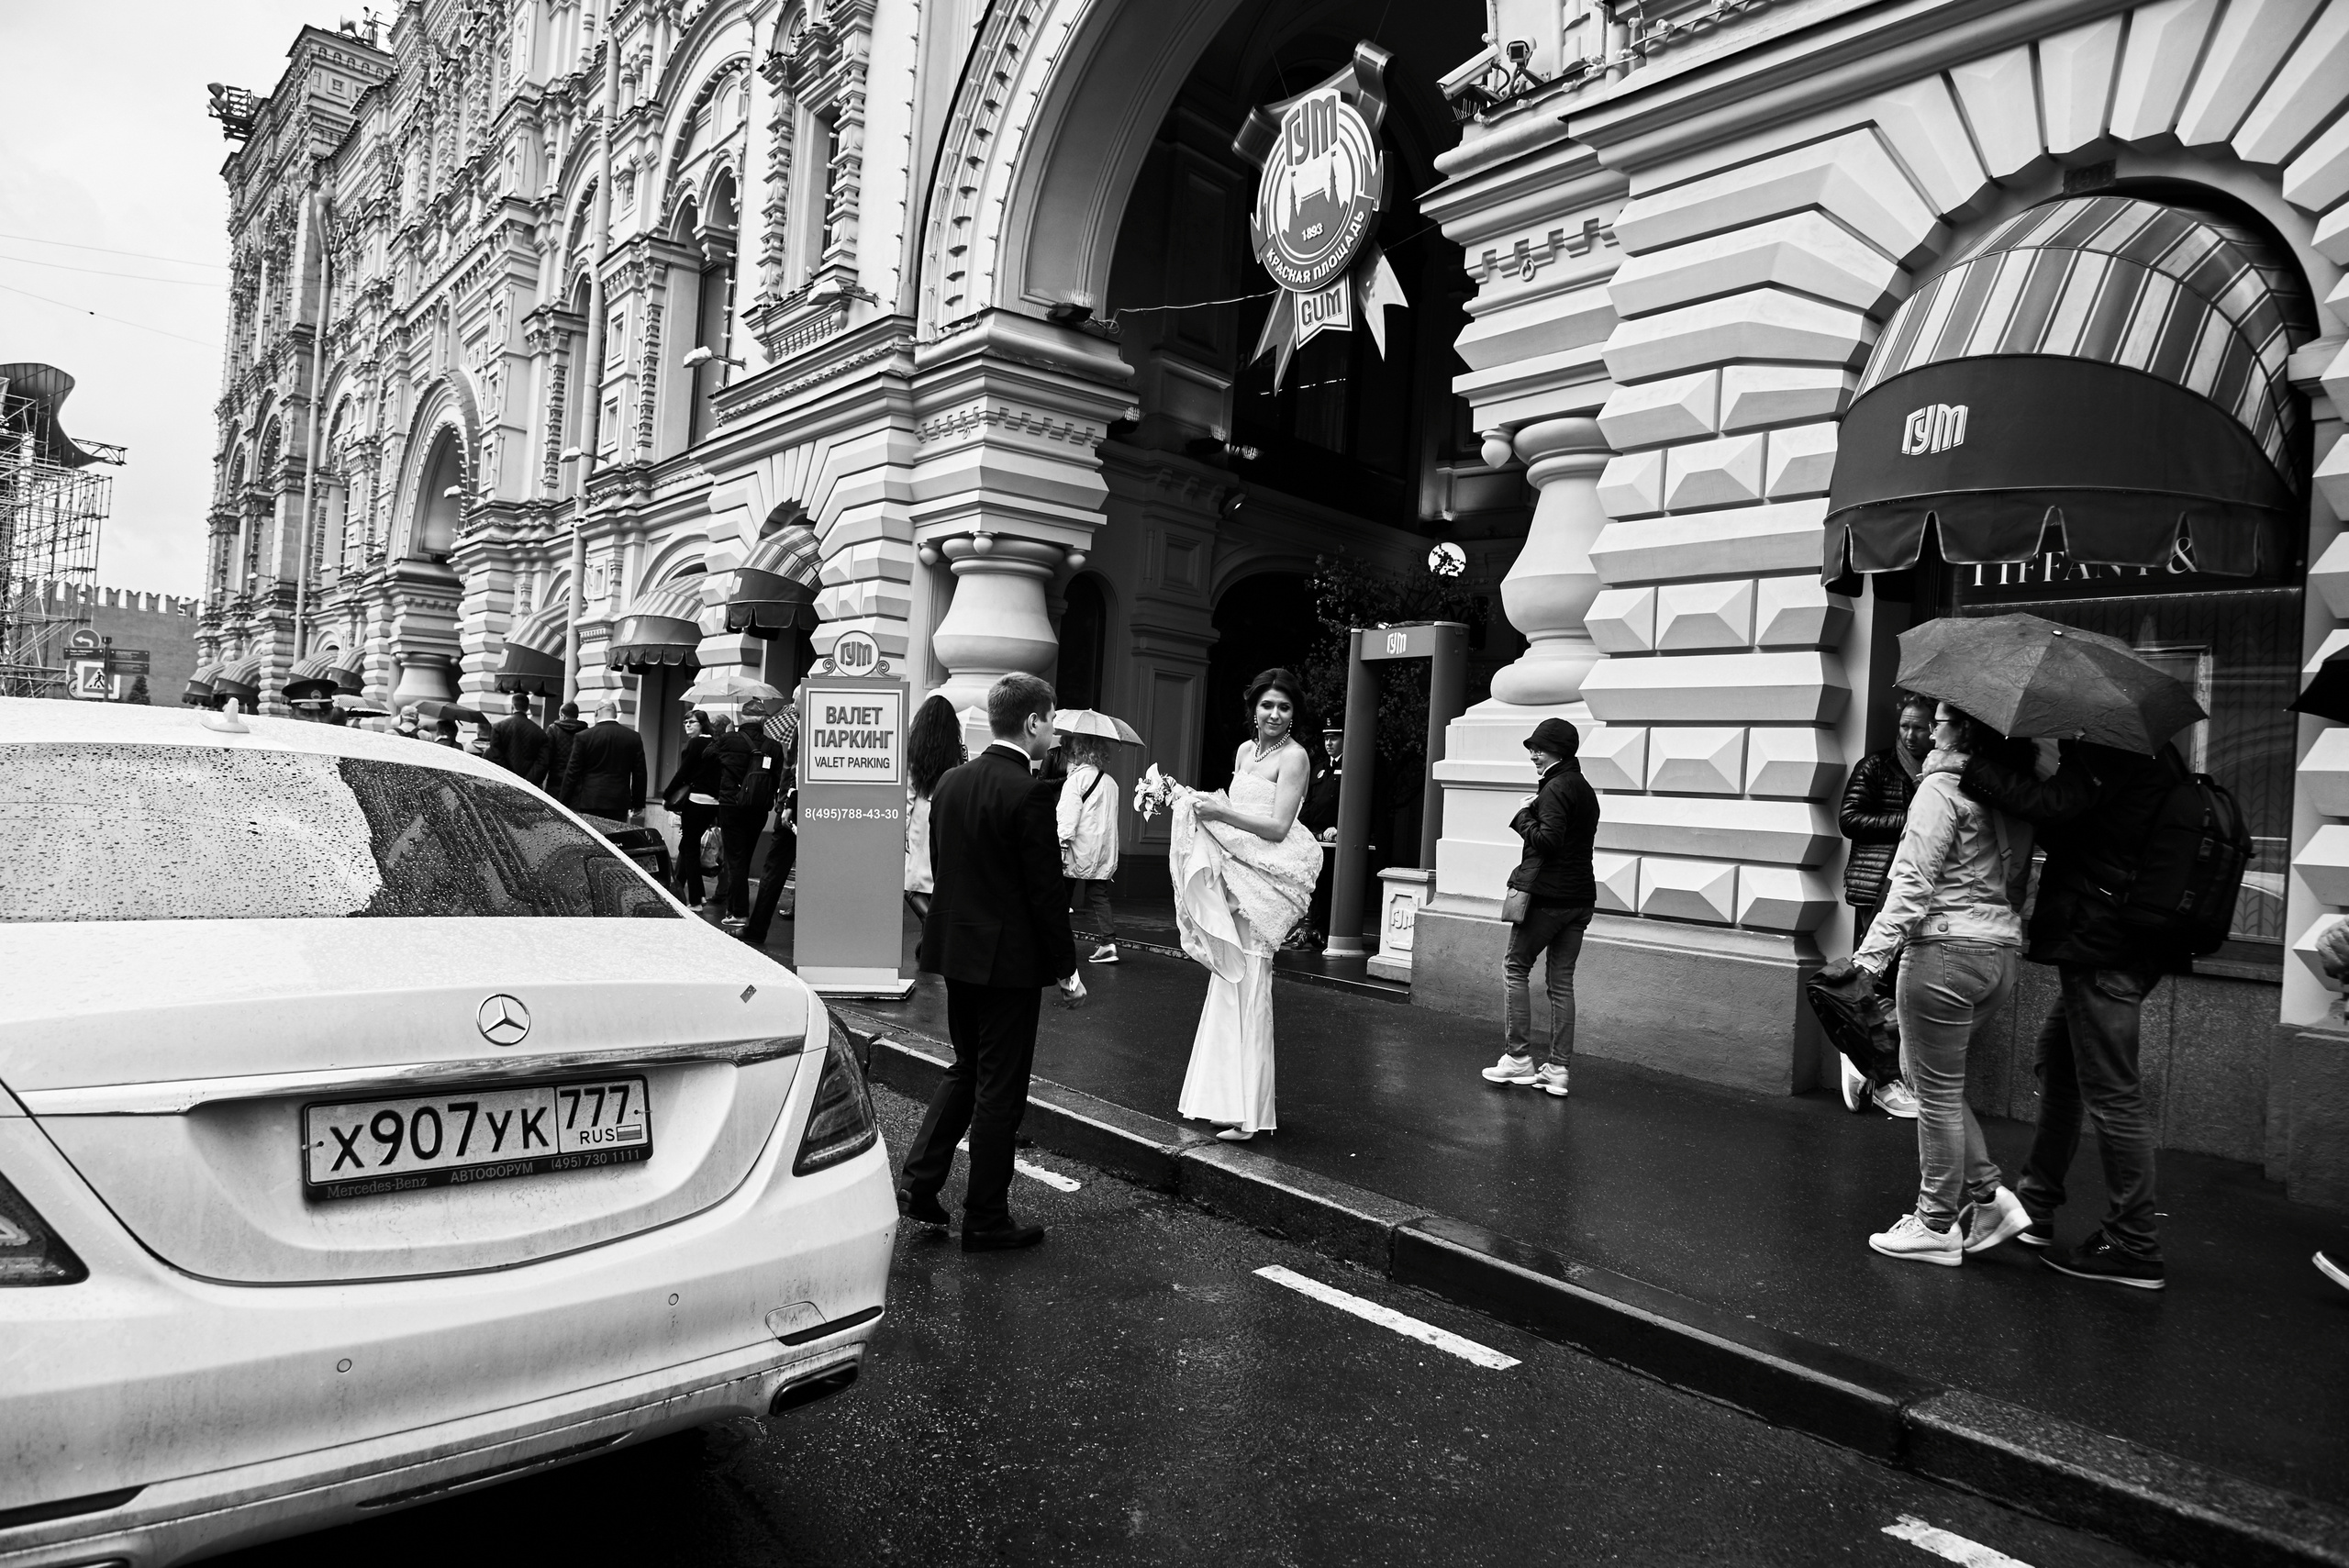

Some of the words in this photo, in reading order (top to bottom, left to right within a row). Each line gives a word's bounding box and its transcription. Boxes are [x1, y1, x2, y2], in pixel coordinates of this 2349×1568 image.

[1285, 94, 1339, 166] ГУМ
[1301, 222, 1324, 241] 1893
[1266, 248, 1311, 284] КРАСНАЯ
[1313, 210, 1365, 281] ПЛОЩАДЬ
[1301, 287, 1343, 328] GUM
[1901, 403, 1969, 456] ГУМ
[2166, 537, 2199, 574] &
[840, 641, 873, 667] ГУМ
[1386, 631, 1408, 655] ГУМ
[826, 706, 884, 725] ВАЛЕТ
[814, 729, 894, 749] ПАРКИНГ
[814, 756, 845, 768] VALET
[847, 757, 890, 769] PARKING
[805, 807, 899, 821] 8(495)788-43-30
[559, 1085, 630, 1129] 777
[579, 1129, 615, 1145] RUS
[327, 1176, 429, 1200] Mercedes-Benz
[450, 1162, 534, 1184] АВТОФОРУМ
[551, 1155, 582, 1171] (495)
[584, 1152, 607, 1167] 730
[613, 1150, 640, 1163] 1111
